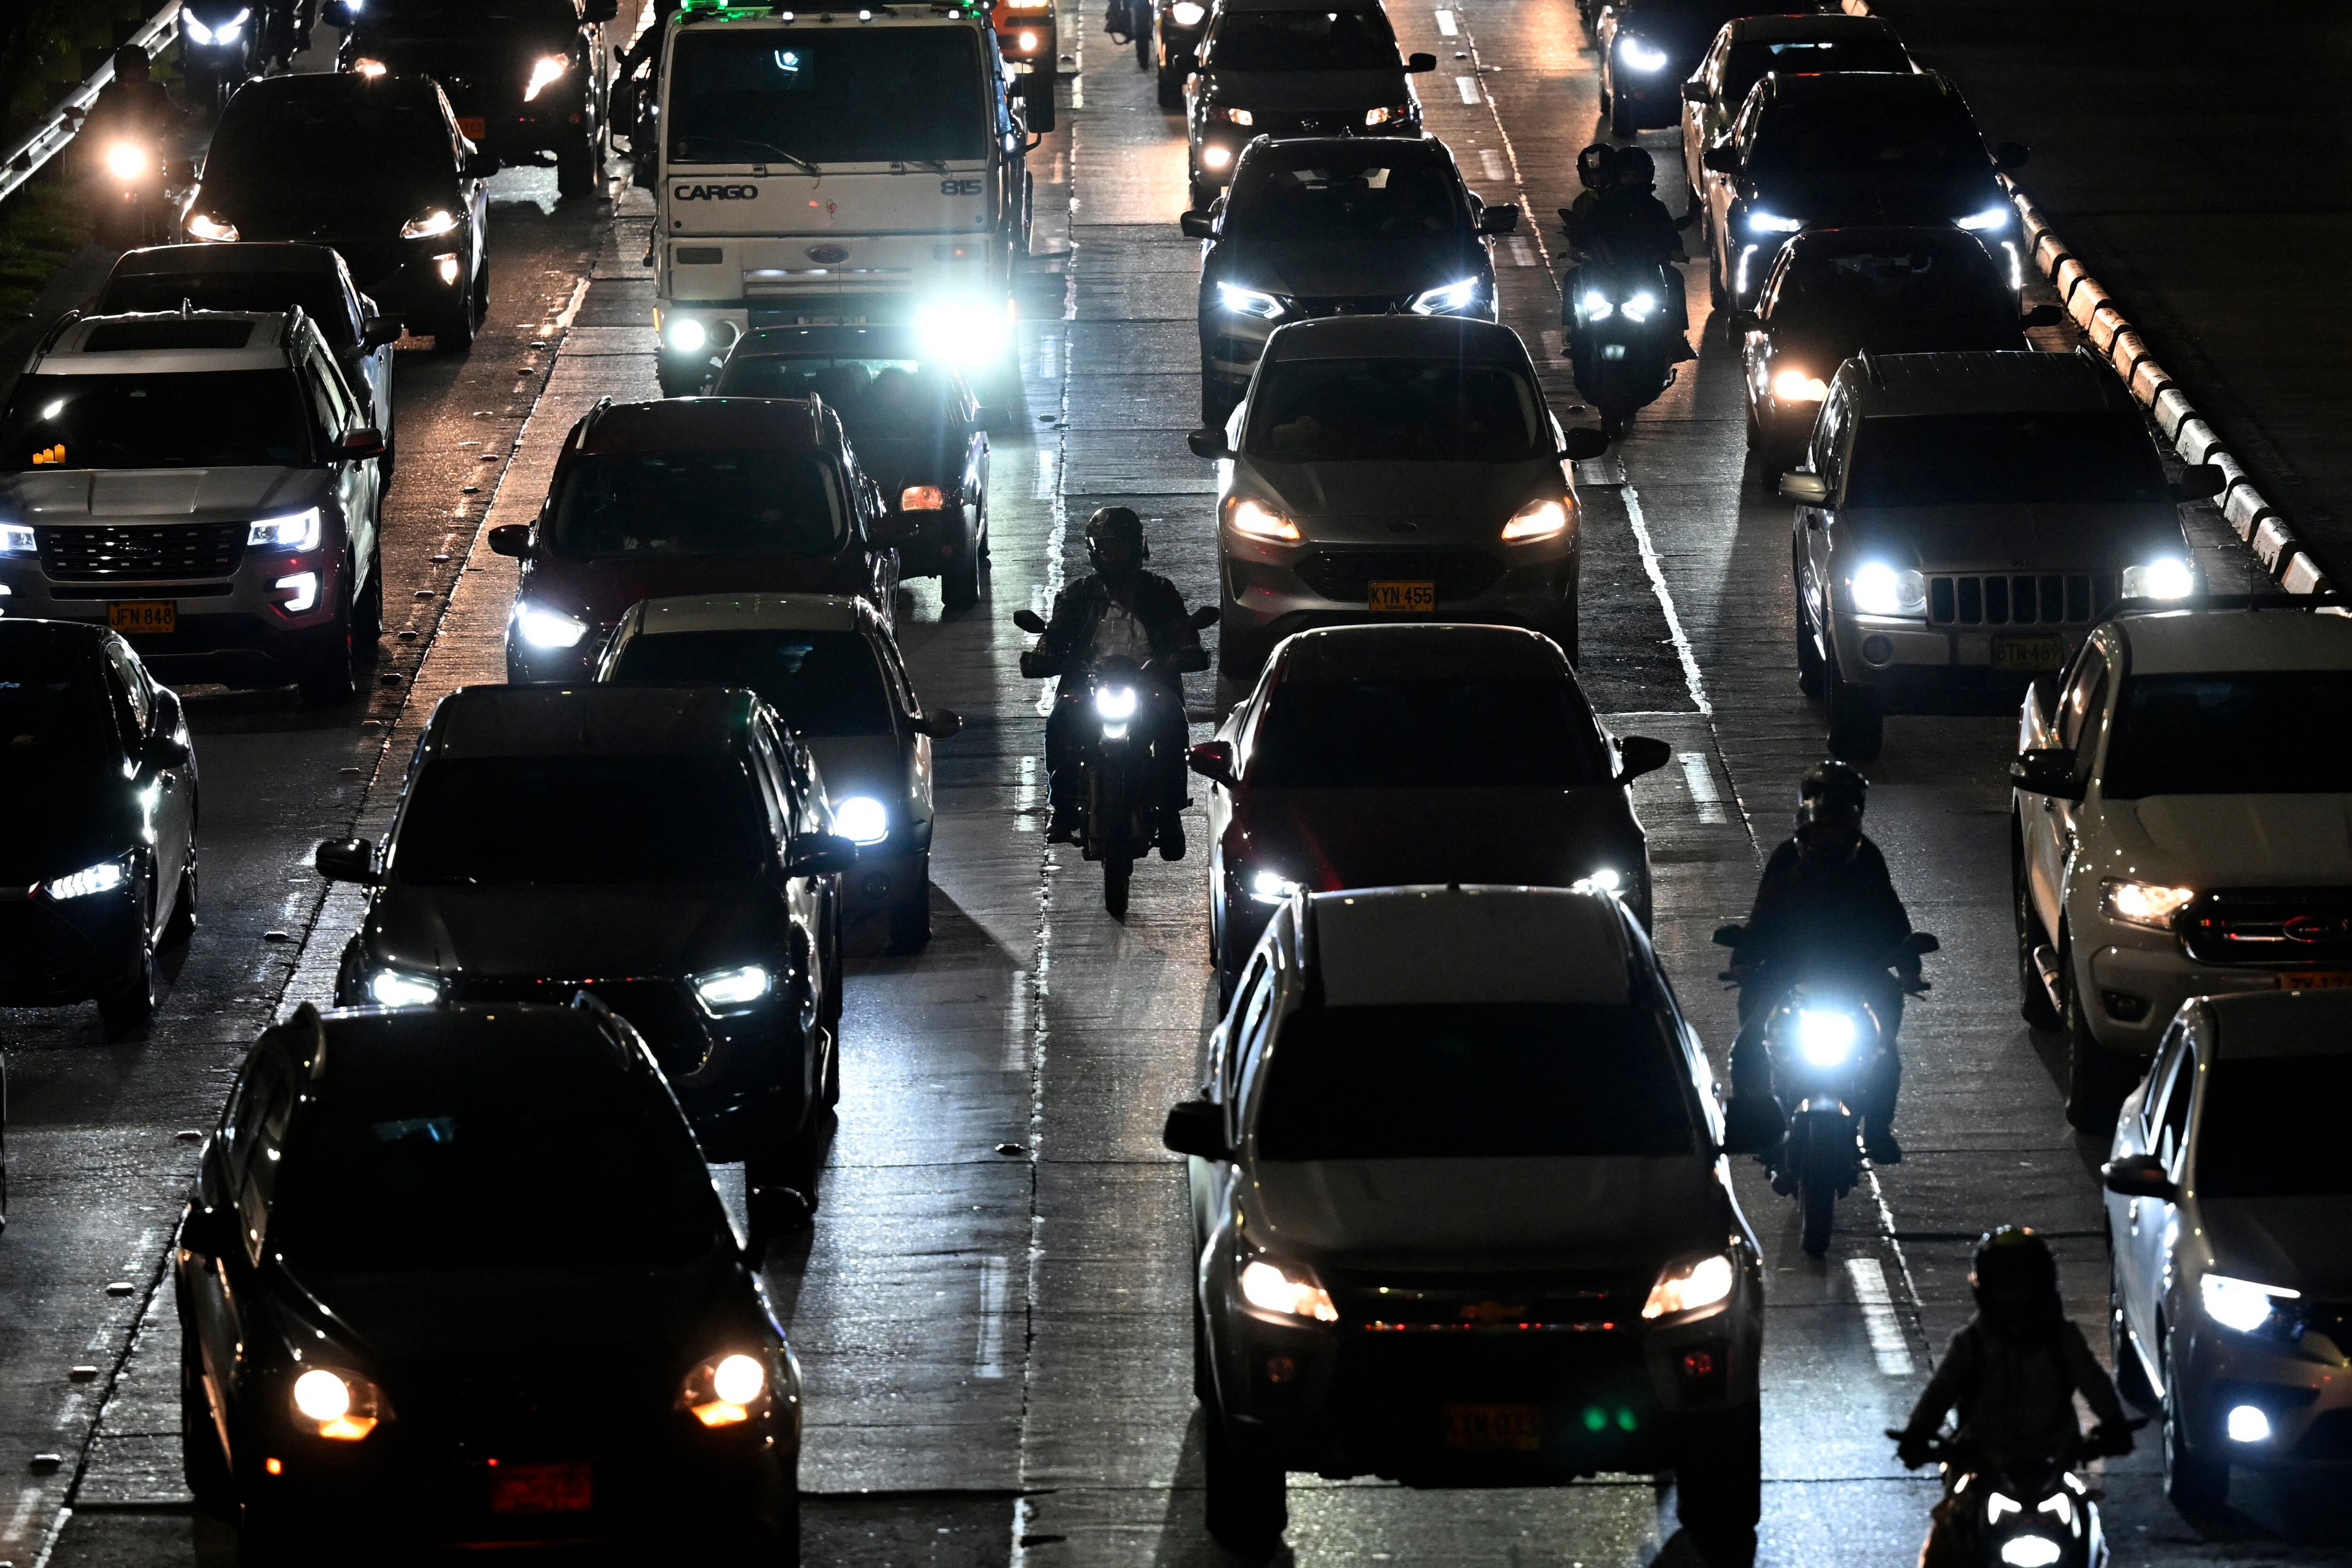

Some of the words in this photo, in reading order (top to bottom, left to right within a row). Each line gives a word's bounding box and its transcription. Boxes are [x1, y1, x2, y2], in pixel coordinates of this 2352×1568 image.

[674, 185, 758, 200] CARGO
[941, 180, 983, 196] 815
[1372, 587, 1400, 604] KYN
[1404, 587, 1432, 604] 455
[111, 608, 140, 625] JFN
[144, 608, 173, 625] 848
[1997, 643, 2026, 661] BTN
